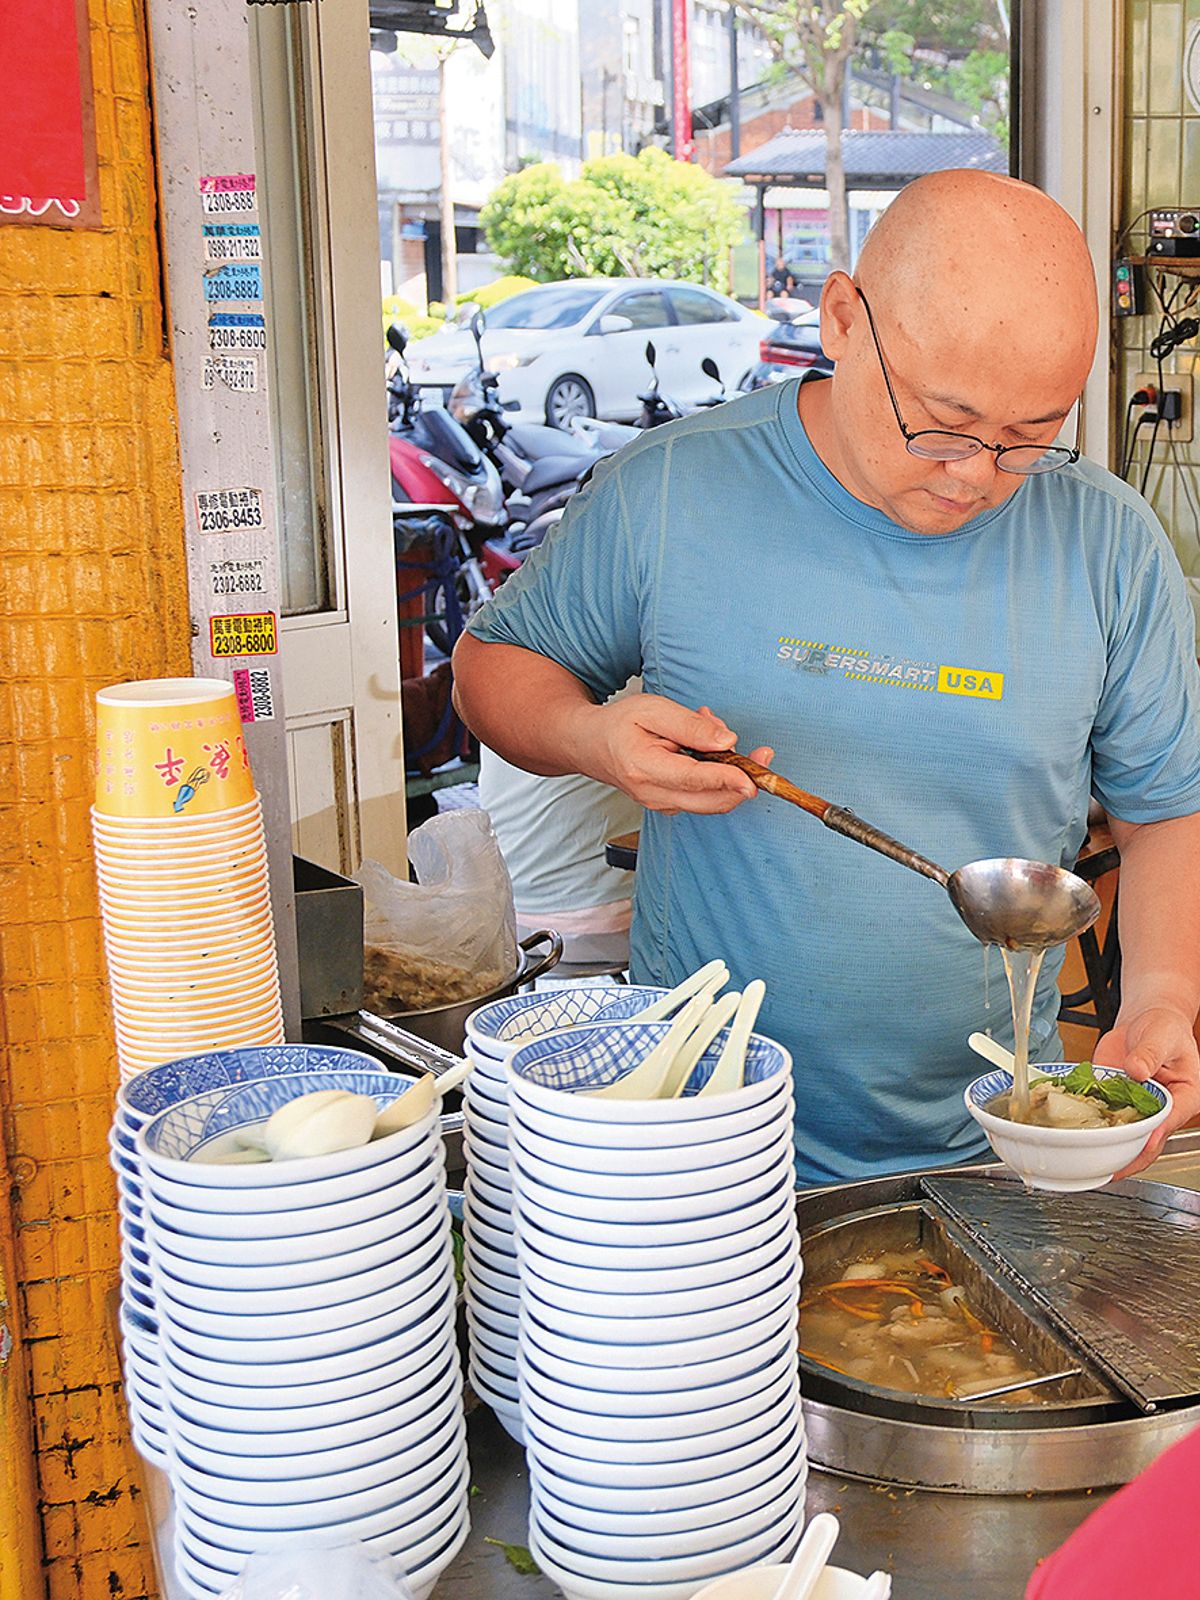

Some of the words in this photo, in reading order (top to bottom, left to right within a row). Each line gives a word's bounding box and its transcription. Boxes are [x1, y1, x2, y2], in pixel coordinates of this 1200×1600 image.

[210, 329, 266, 348] 2308-6800
[201, 507, 262, 530] 2306-8453
[215, 634, 274, 654] 2308-6800
[777, 645, 936, 683] SUPERSMART
[946, 672, 994, 694] USA
